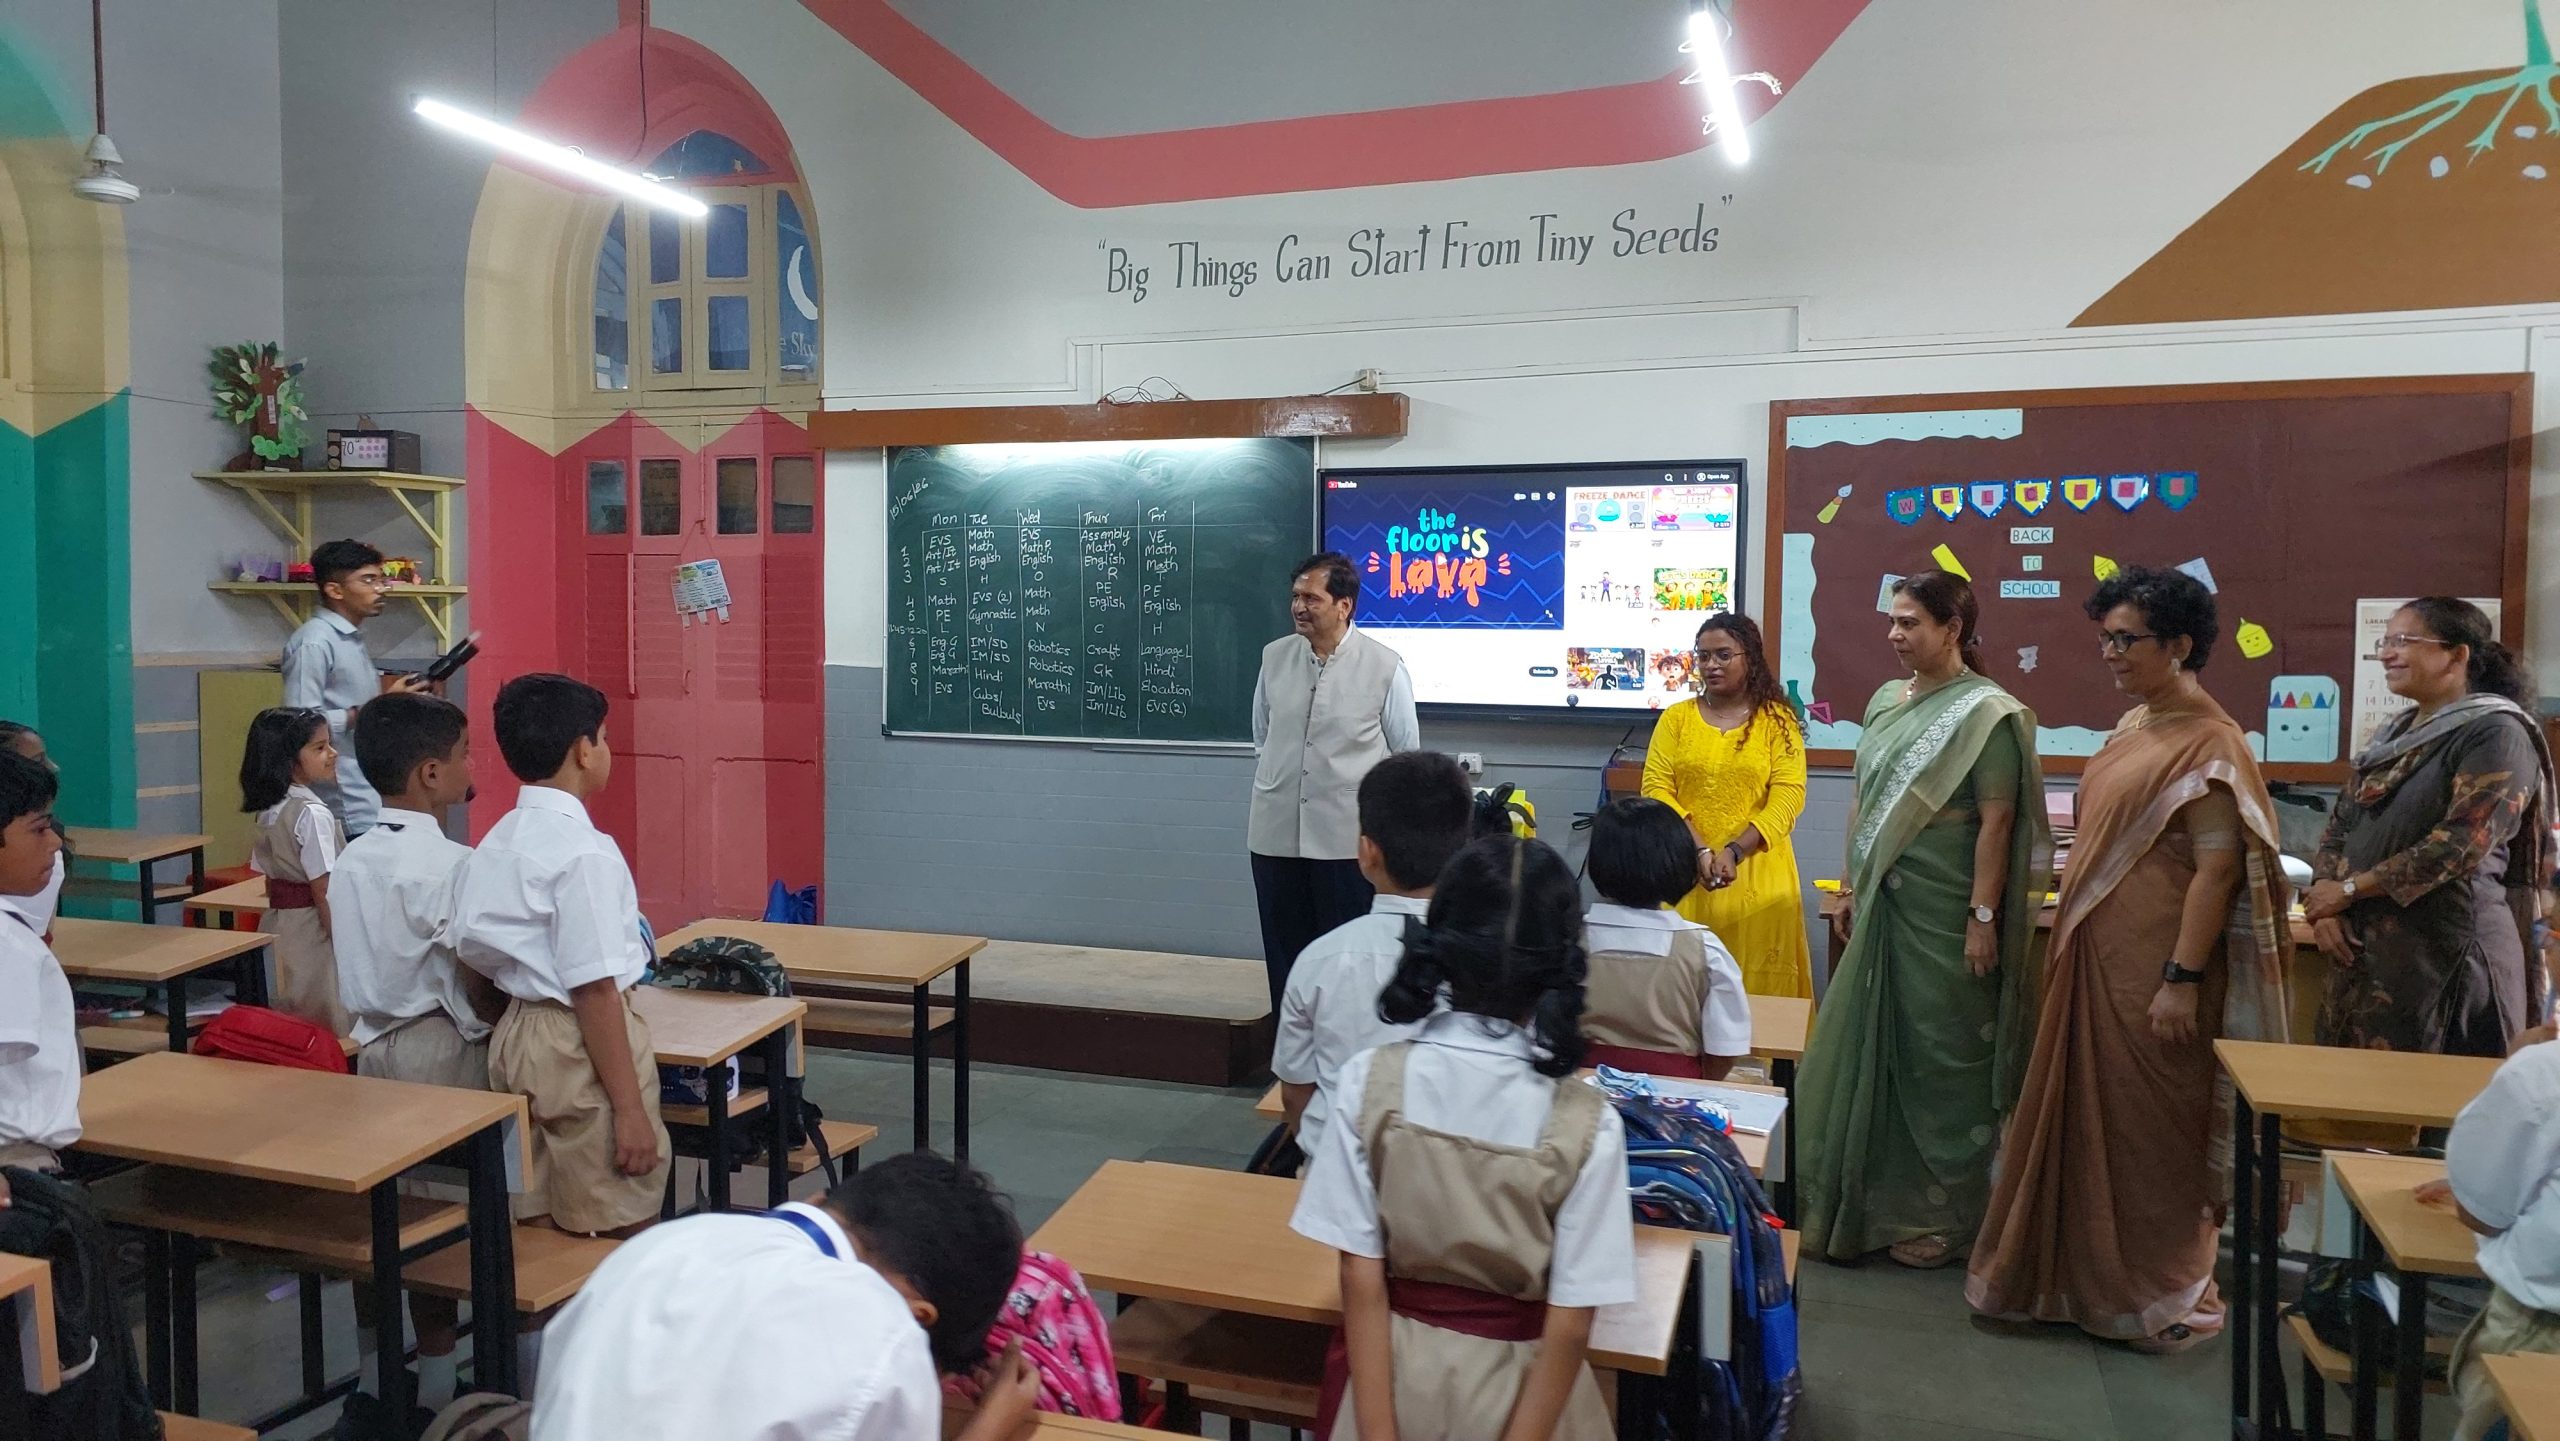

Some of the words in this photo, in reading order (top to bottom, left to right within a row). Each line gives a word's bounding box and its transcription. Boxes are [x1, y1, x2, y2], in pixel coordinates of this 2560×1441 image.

[1168, 241, 1258, 298] Things
[1275, 234, 1331, 283] Can
[1348, 224, 1431, 278] Start
[1441, 220, 1521, 269] From
[1529, 213, 1595, 266] Tiny
[791, 331, 816, 363] Sky
[1574, 491, 1608, 500] FREEZE
[1613, 490, 1646, 500] DANCE
[932, 513, 958, 527] Mon
[969, 514, 988, 525] Tue
[1020, 508, 1041, 525] Wed
[1083, 511, 1110, 525] Thur
[1147, 506, 1168, 523] Fri
[1417, 508, 1457, 533] the
[930, 534, 951, 549] EVS
[968, 529, 995, 540] Math
[1021, 528, 1041, 542] EVS
[1080, 527, 1131, 546] Assembly
[1149, 529, 1167, 543] VE
[1386, 525, 1460, 555] floor
[2012, 530, 2051, 543] BACK
[900, 546, 909, 557] 1
[968, 543, 994, 555] Math
[1020, 541, 1043, 555] Math
[1085, 541, 1116, 554] Math
[1145, 541, 1177, 557] Math
[903, 558, 911, 567] 2
[969, 551, 1001, 570] English
[1022, 552, 1053, 569] English
[1084, 552, 1126, 571] English
[1146, 557, 1178, 572] Math
[2024, 557, 2041, 570] TO
[903, 570, 912, 583] 3
[981, 573, 989, 585] H
[1107, 566, 1118, 580] R
[939, 577, 948, 586] S
[1096, 581, 1112, 594] PE
[1024, 587, 1051, 599] Math
[2002, 583, 2059, 596] SCHOOL
[906, 595, 914, 608] 4
[928, 593, 957, 606] Math
[972, 591, 993, 605] EVS
[1089, 595, 1126, 612] English
[1025, 603, 1051, 617] Math
[1143, 598, 1181, 616] English
[908, 610, 915, 621] 5
[936, 609, 951, 622] PE
[968, 607, 1017, 625] Gymnastic
[940, 622, 950, 633] L
[1035, 622, 1046, 632] N
[1093, 623, 1105, 634] C
[1153, 621, 1163, 636] H
[908, 638, 915, 647] 6
[1028, 639, 1071, 656] Robotics
[909, 648, 916, 658] 7
[1086, 643, 1121, 661] Craft
[910, 662, 917, 675] 8
[1028, 656, 1076, 676] Robotics
[1144, 662, 1176, 678] Hindi
[975, 667, 1003, 683] Hindi
[911, 678, 919, 696] 9
[935, 681, 953, 694] EVS
[1028, 677, 1071, 695] Marathi
[1141, 680, 1191, 697] Elocution
[1037, 696, 1056, 711] EVS
[2365, 697, 2376, 706] 14
[2384, 696, 2394, 705] 15
[982, 703, 1022, 725] Bulbuls
[2365, 712, 2376, 721] 21
